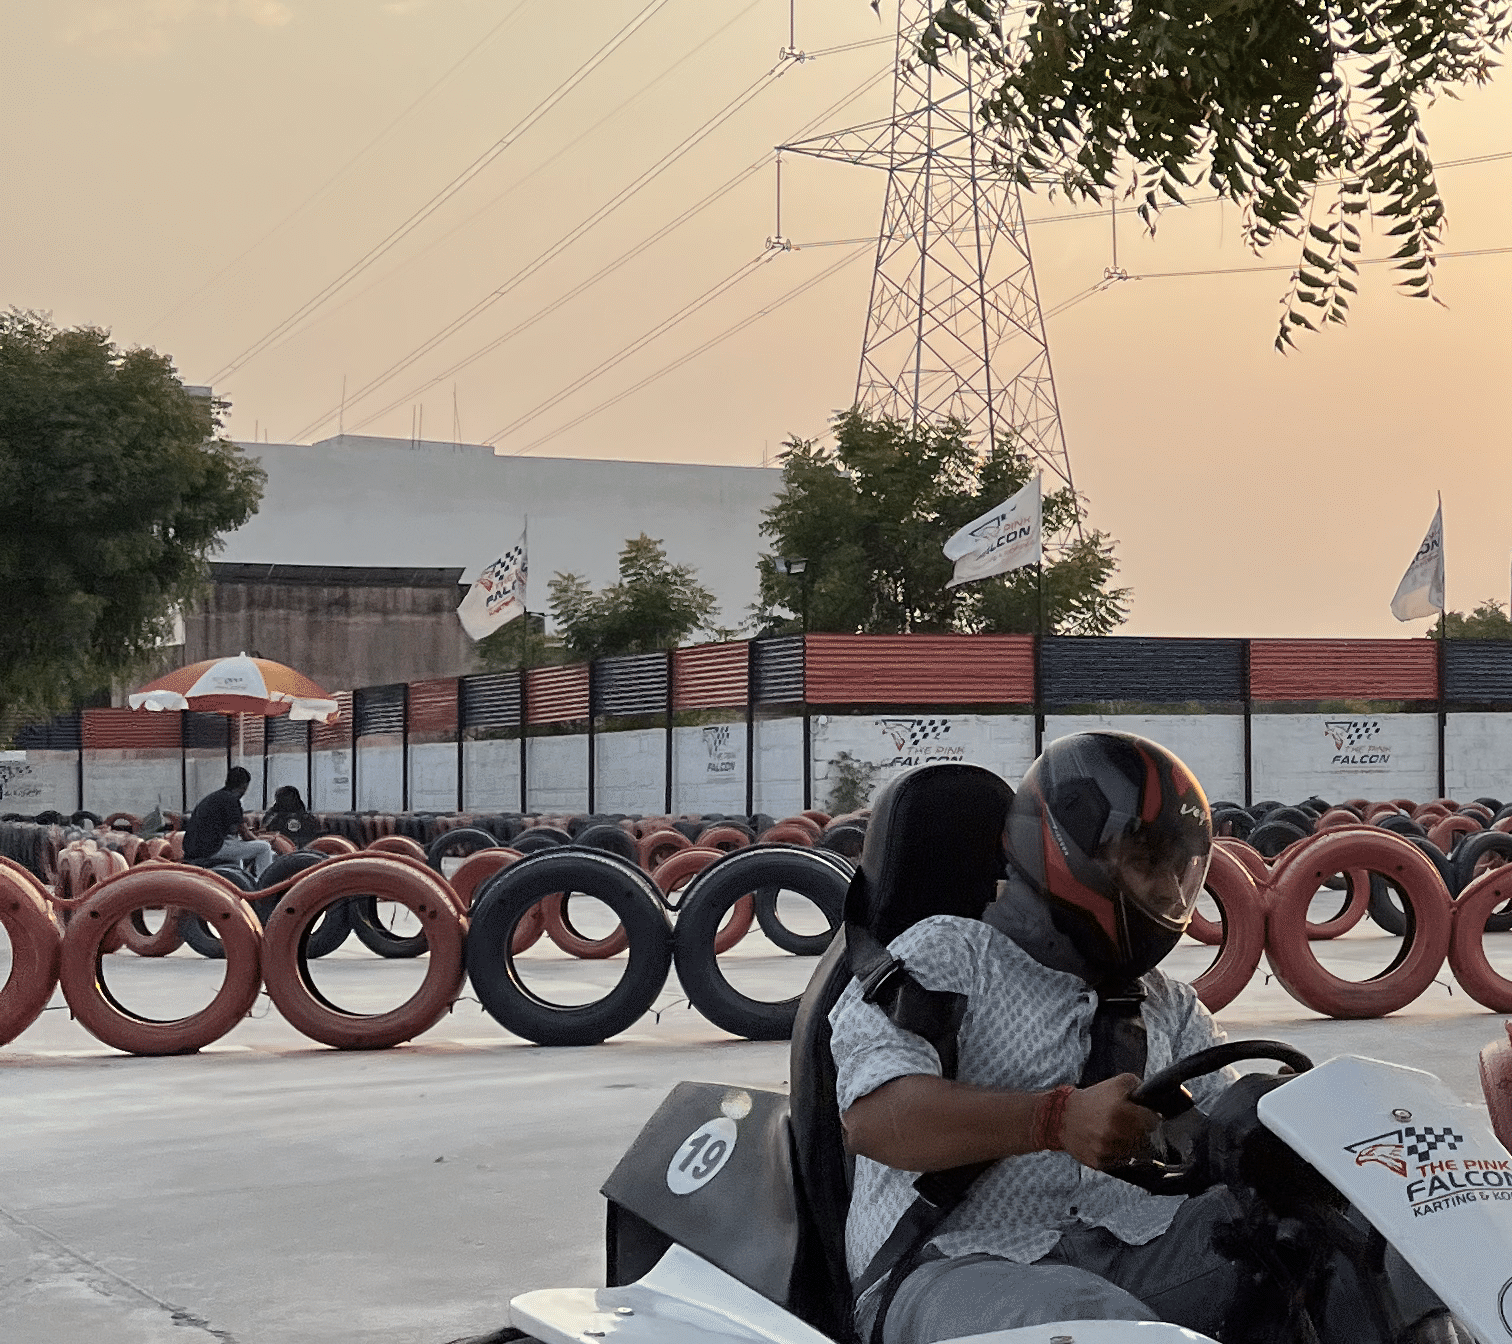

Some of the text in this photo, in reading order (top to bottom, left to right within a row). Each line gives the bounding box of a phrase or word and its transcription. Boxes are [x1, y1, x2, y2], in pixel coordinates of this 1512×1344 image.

[906, 746, 966, 755] THE PINK
[1331, 754, 1391, 764] FALCON
[678, 1133, 727, 1180] 19
[1416, 1159, 1512, 1177] THE PINK
[1413, 1192, 1477, 1218] KARTING
[1478, 1191, 1490, 1201] &
